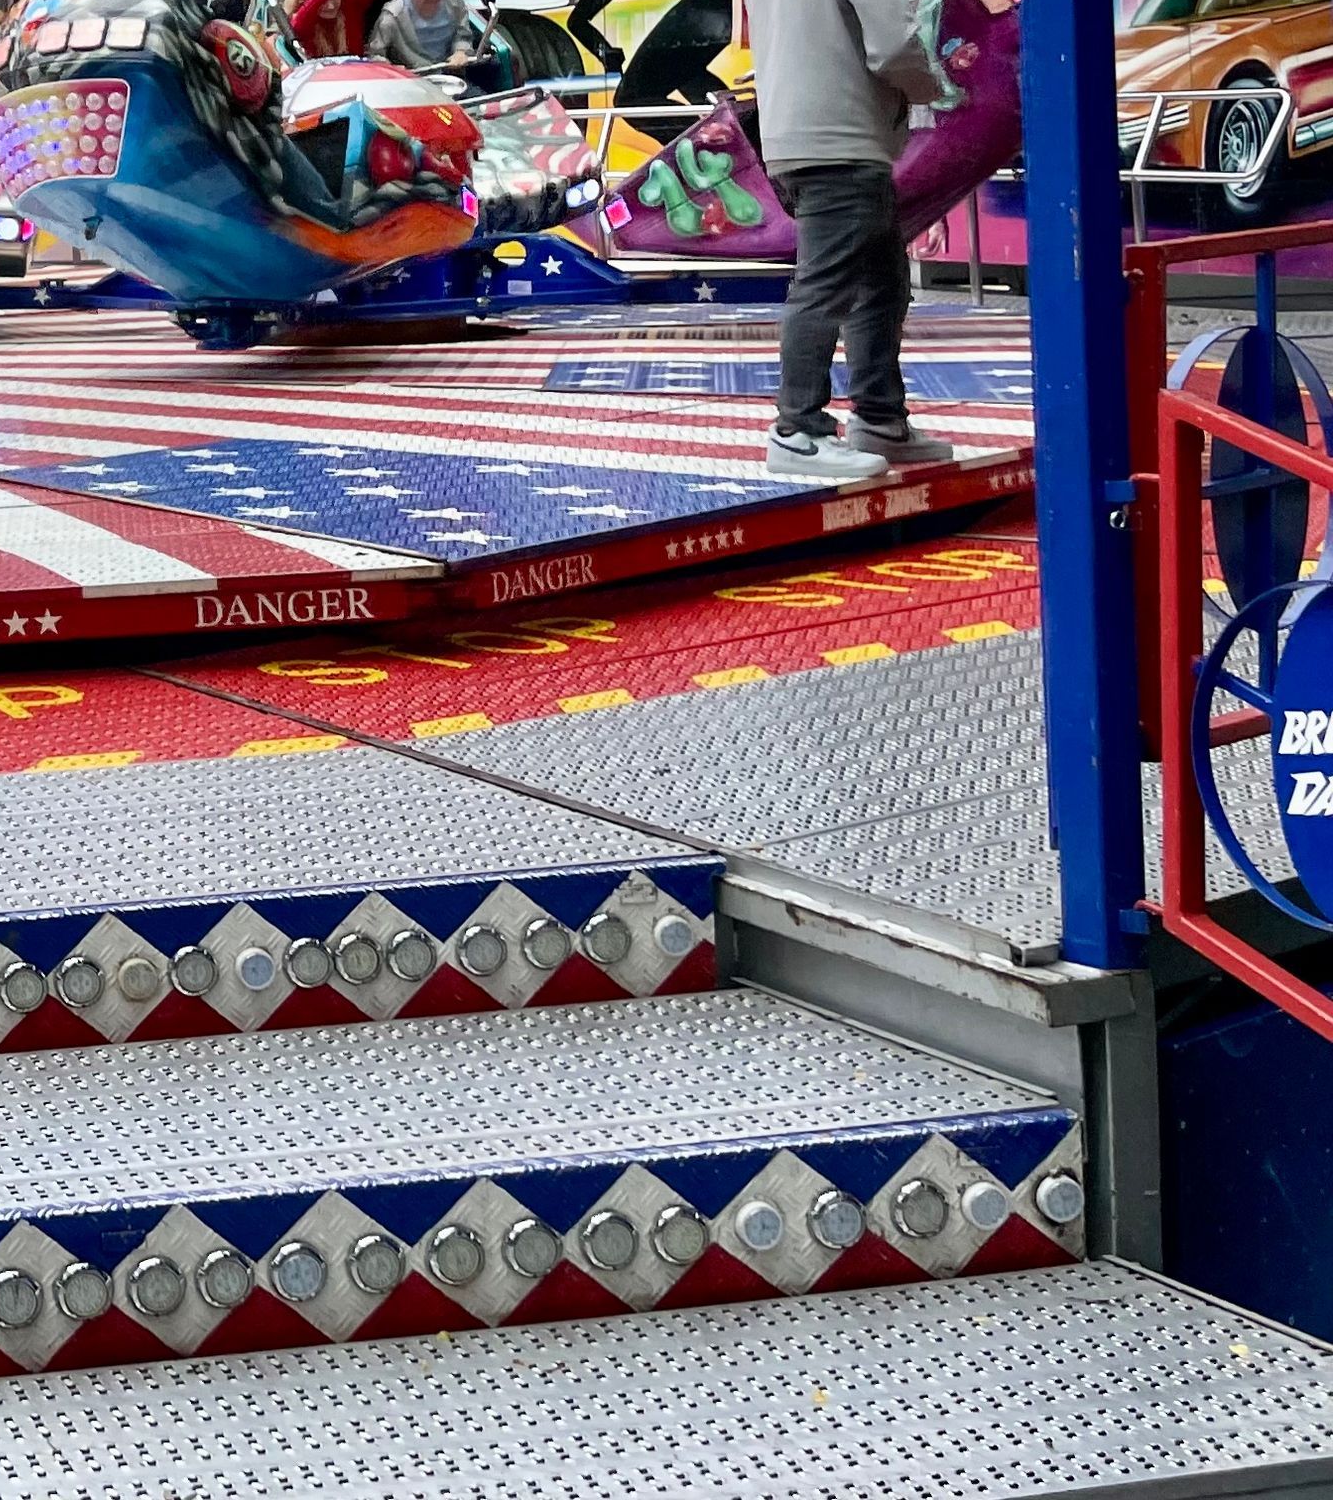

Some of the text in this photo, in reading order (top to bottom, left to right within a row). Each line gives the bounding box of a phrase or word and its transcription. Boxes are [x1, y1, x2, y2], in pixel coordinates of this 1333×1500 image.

[490, 553, 598, 604] DANGER
[193, 587, 375, 630] DANGER
[257, 615, 624, 687] STOP
